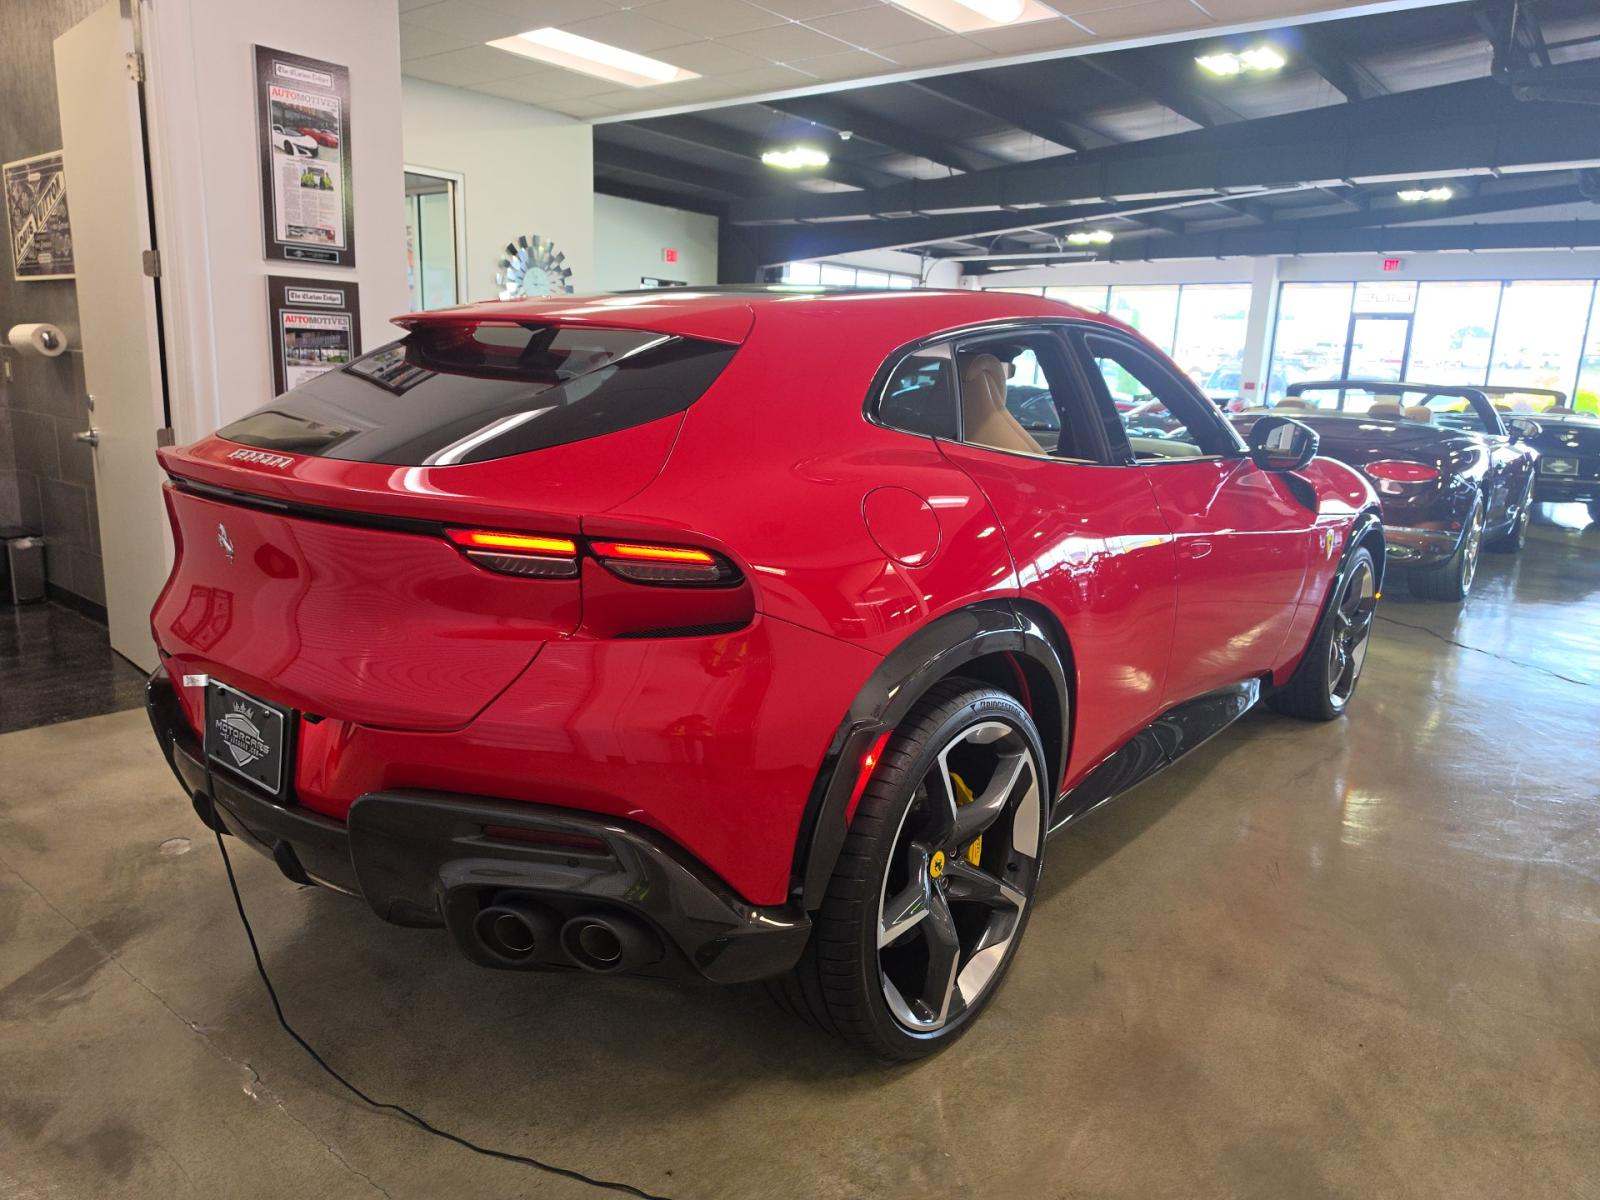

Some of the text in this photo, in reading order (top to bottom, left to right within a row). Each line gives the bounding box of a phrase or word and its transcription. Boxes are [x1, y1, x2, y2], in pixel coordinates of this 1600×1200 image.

[271, 87, 338, 108] AUTOMOTIVES
[285, 315, 348, 326] AUTOMOTIVES
[215, 719, 270, 754] MOTORCARS
